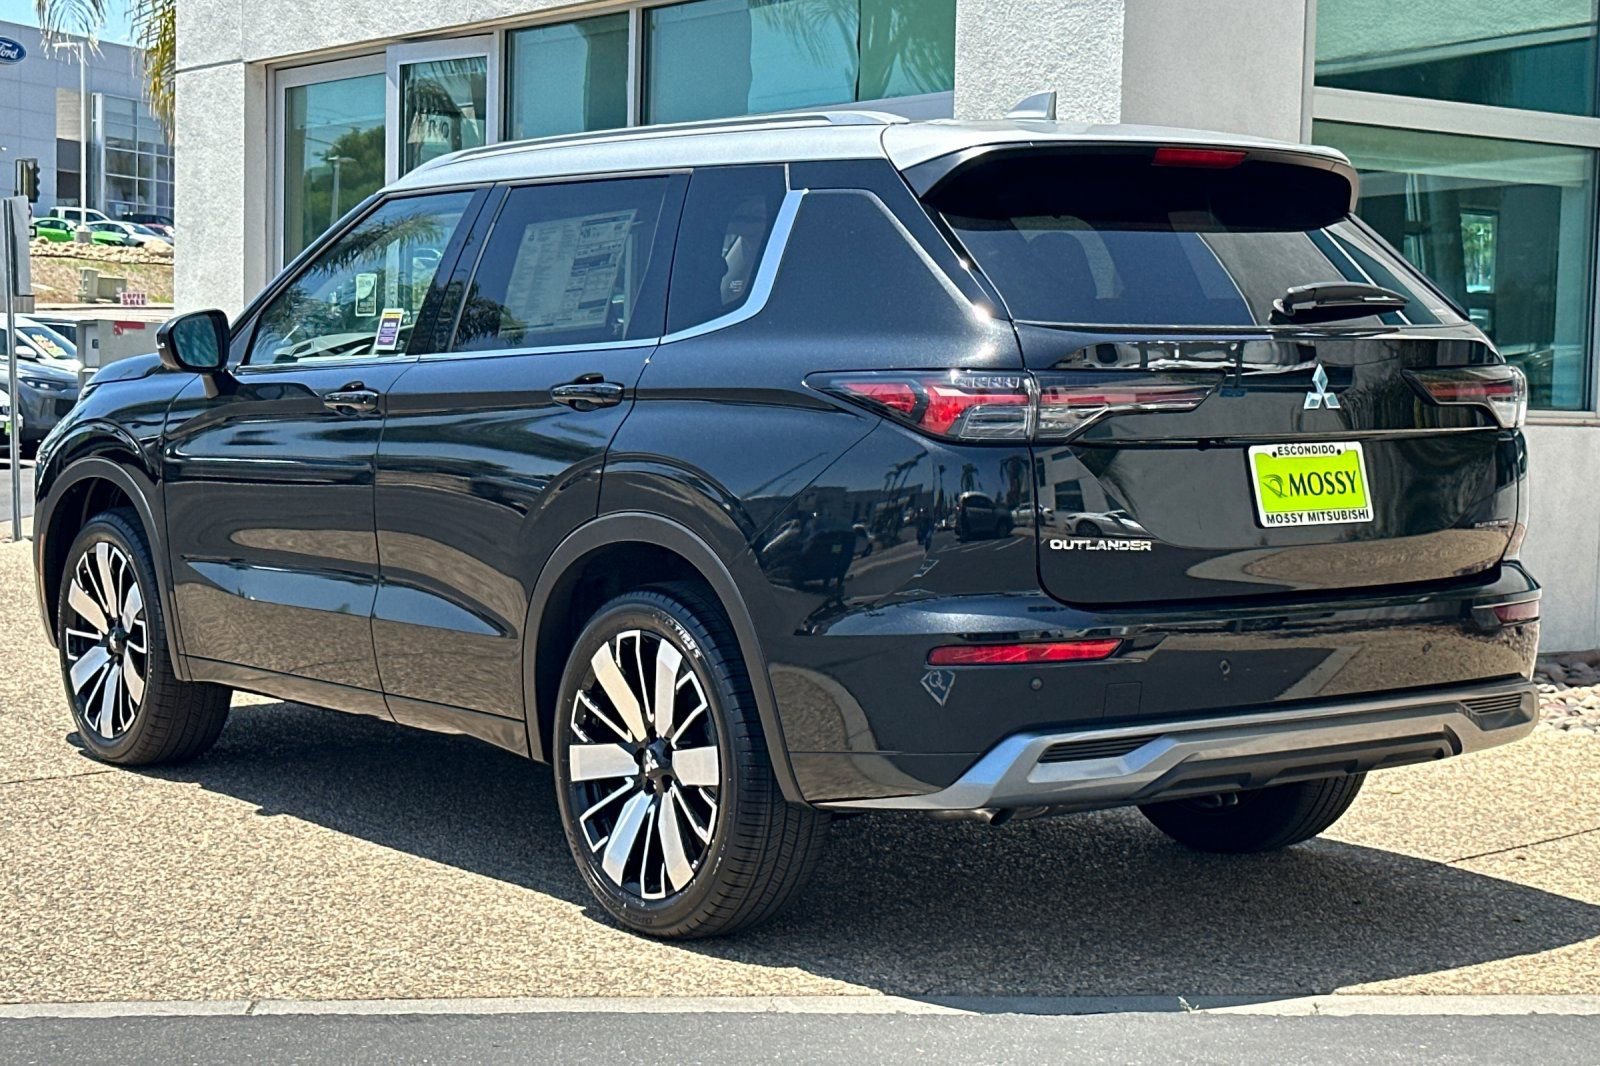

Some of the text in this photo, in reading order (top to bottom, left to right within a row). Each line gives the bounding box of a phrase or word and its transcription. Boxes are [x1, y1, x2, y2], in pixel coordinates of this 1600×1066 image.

[1277, 444, 1336, 456] ESCONDIDO
[1289, 470, 1357, 497] MOSSY
[1265, 508, 1370, 525] MOSSY MITSUBISHI
[1049, 538, 1153, 552] OUTLANDER
